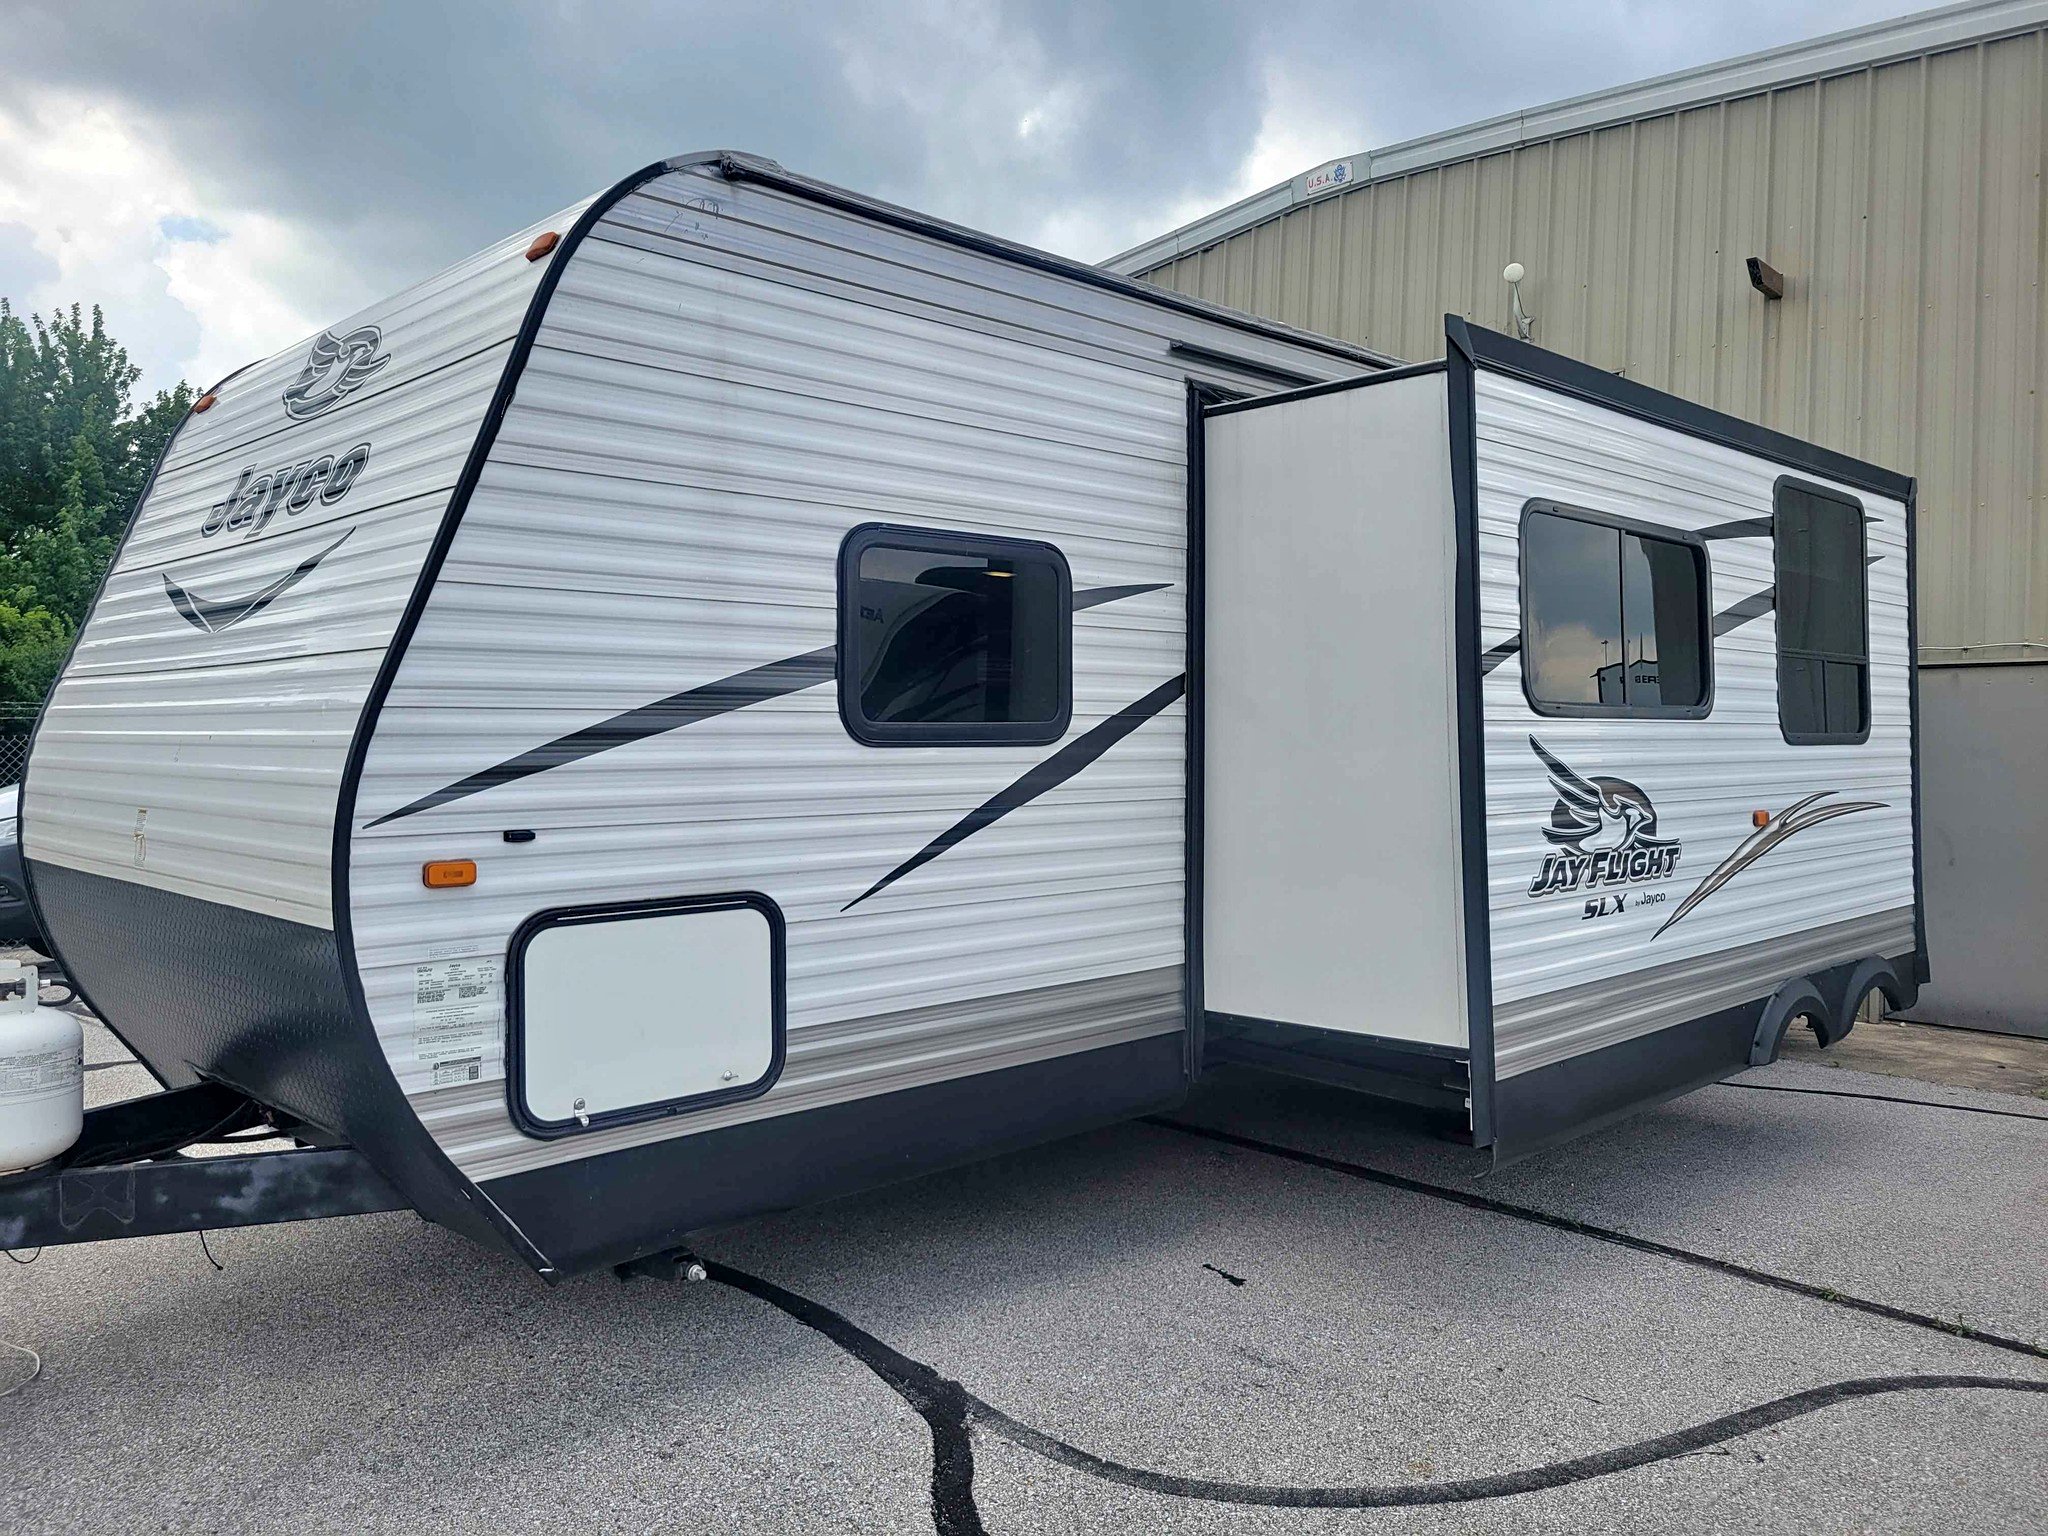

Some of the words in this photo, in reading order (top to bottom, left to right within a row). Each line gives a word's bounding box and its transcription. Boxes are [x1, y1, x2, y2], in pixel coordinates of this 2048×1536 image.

[200, 442, 372, 540] Jayco
[1581, 893, 1628, 921] SLX
[1640, 892, 1666, 907] Jayco
